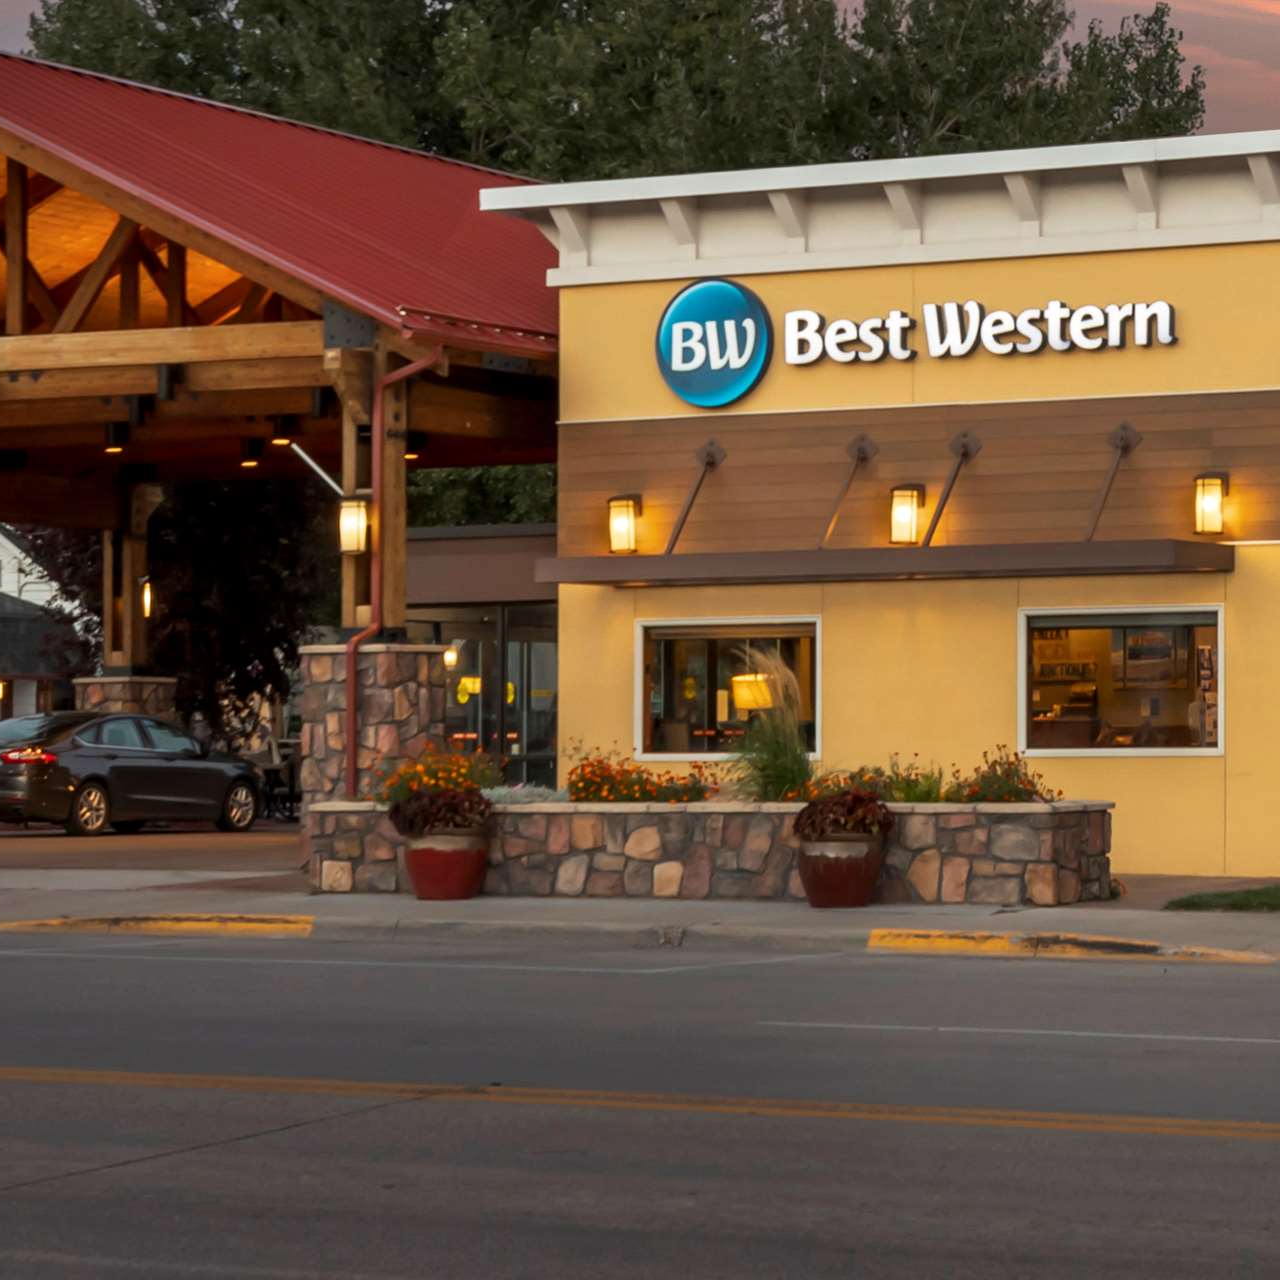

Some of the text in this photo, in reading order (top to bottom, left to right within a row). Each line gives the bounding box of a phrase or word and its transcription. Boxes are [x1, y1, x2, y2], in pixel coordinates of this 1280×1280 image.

[671, 319, 756, 371] BW
[784, 300, 1174, 365] Best Western
